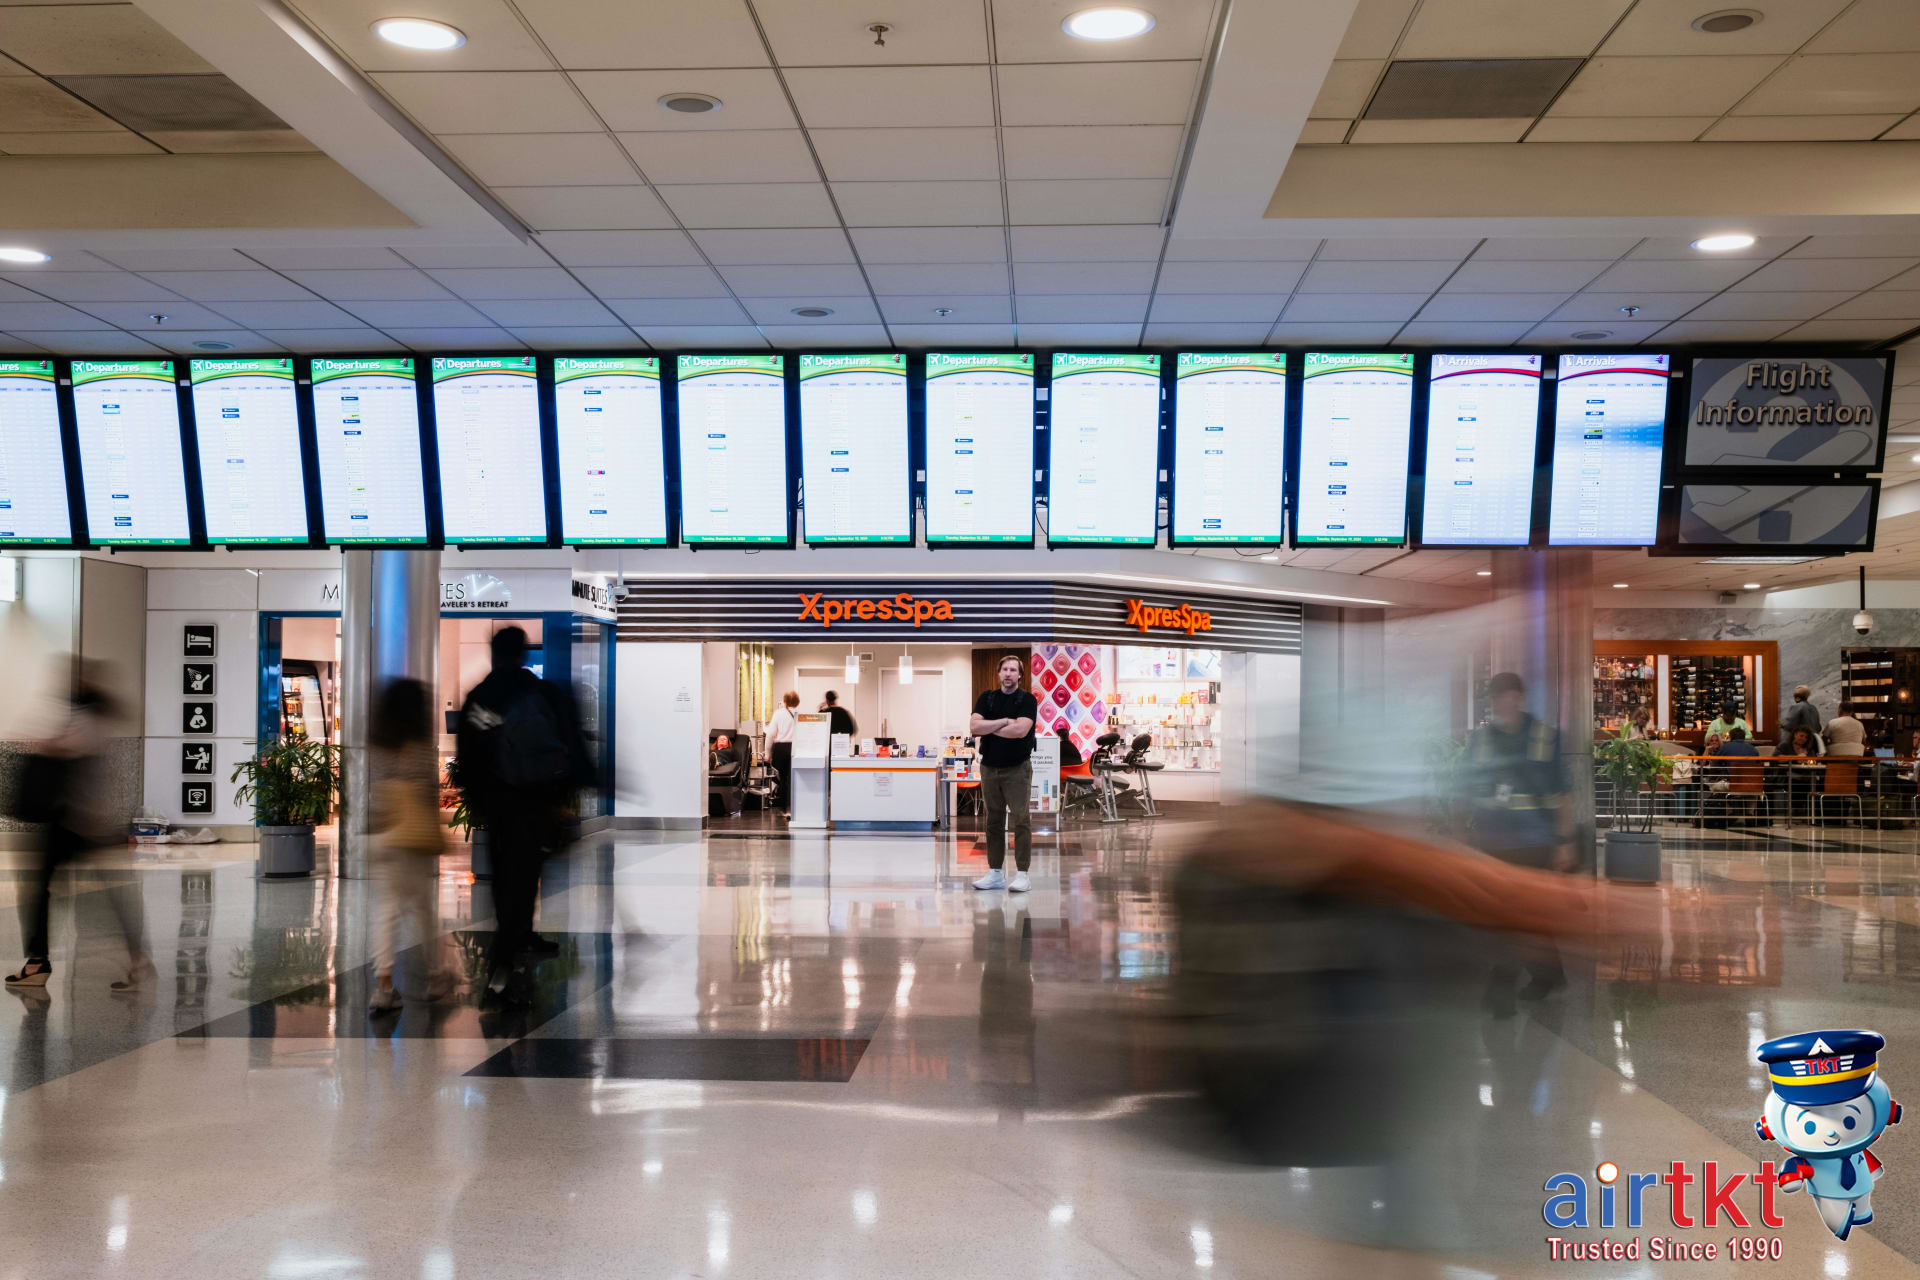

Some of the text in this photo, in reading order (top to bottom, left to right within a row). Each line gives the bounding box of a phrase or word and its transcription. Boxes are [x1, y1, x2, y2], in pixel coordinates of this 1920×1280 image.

[205, 360, 259, 371] Departures
[326, 360, 381, 371] Departures
[447, 358, 501, 369] Departures
[570, 359, 625, 370] Departures
[693, 357, 748, 368] Departures
[816, 357, 871, 368] Departures
[943, 356, 999, 367] Departures
[1069, 356, 1125, 366] Departures
[1193, 355, 1250, 366] Departures
[1321, 355, 1377, 366] Departures
[1447, 356, 1489, 366] Arrivals
[1575, 356, 1617, 366] Arrivals
[86, 362, 140, 373] Departures
[1746, 362, 1832, 394] Flight
[1696, 399, 1872, 426] Information
[440, 583, 465, 600] ES
[799, 593, 953, 627] XpresSpa
[1127, 600, 1211, 635] XpresSpa
